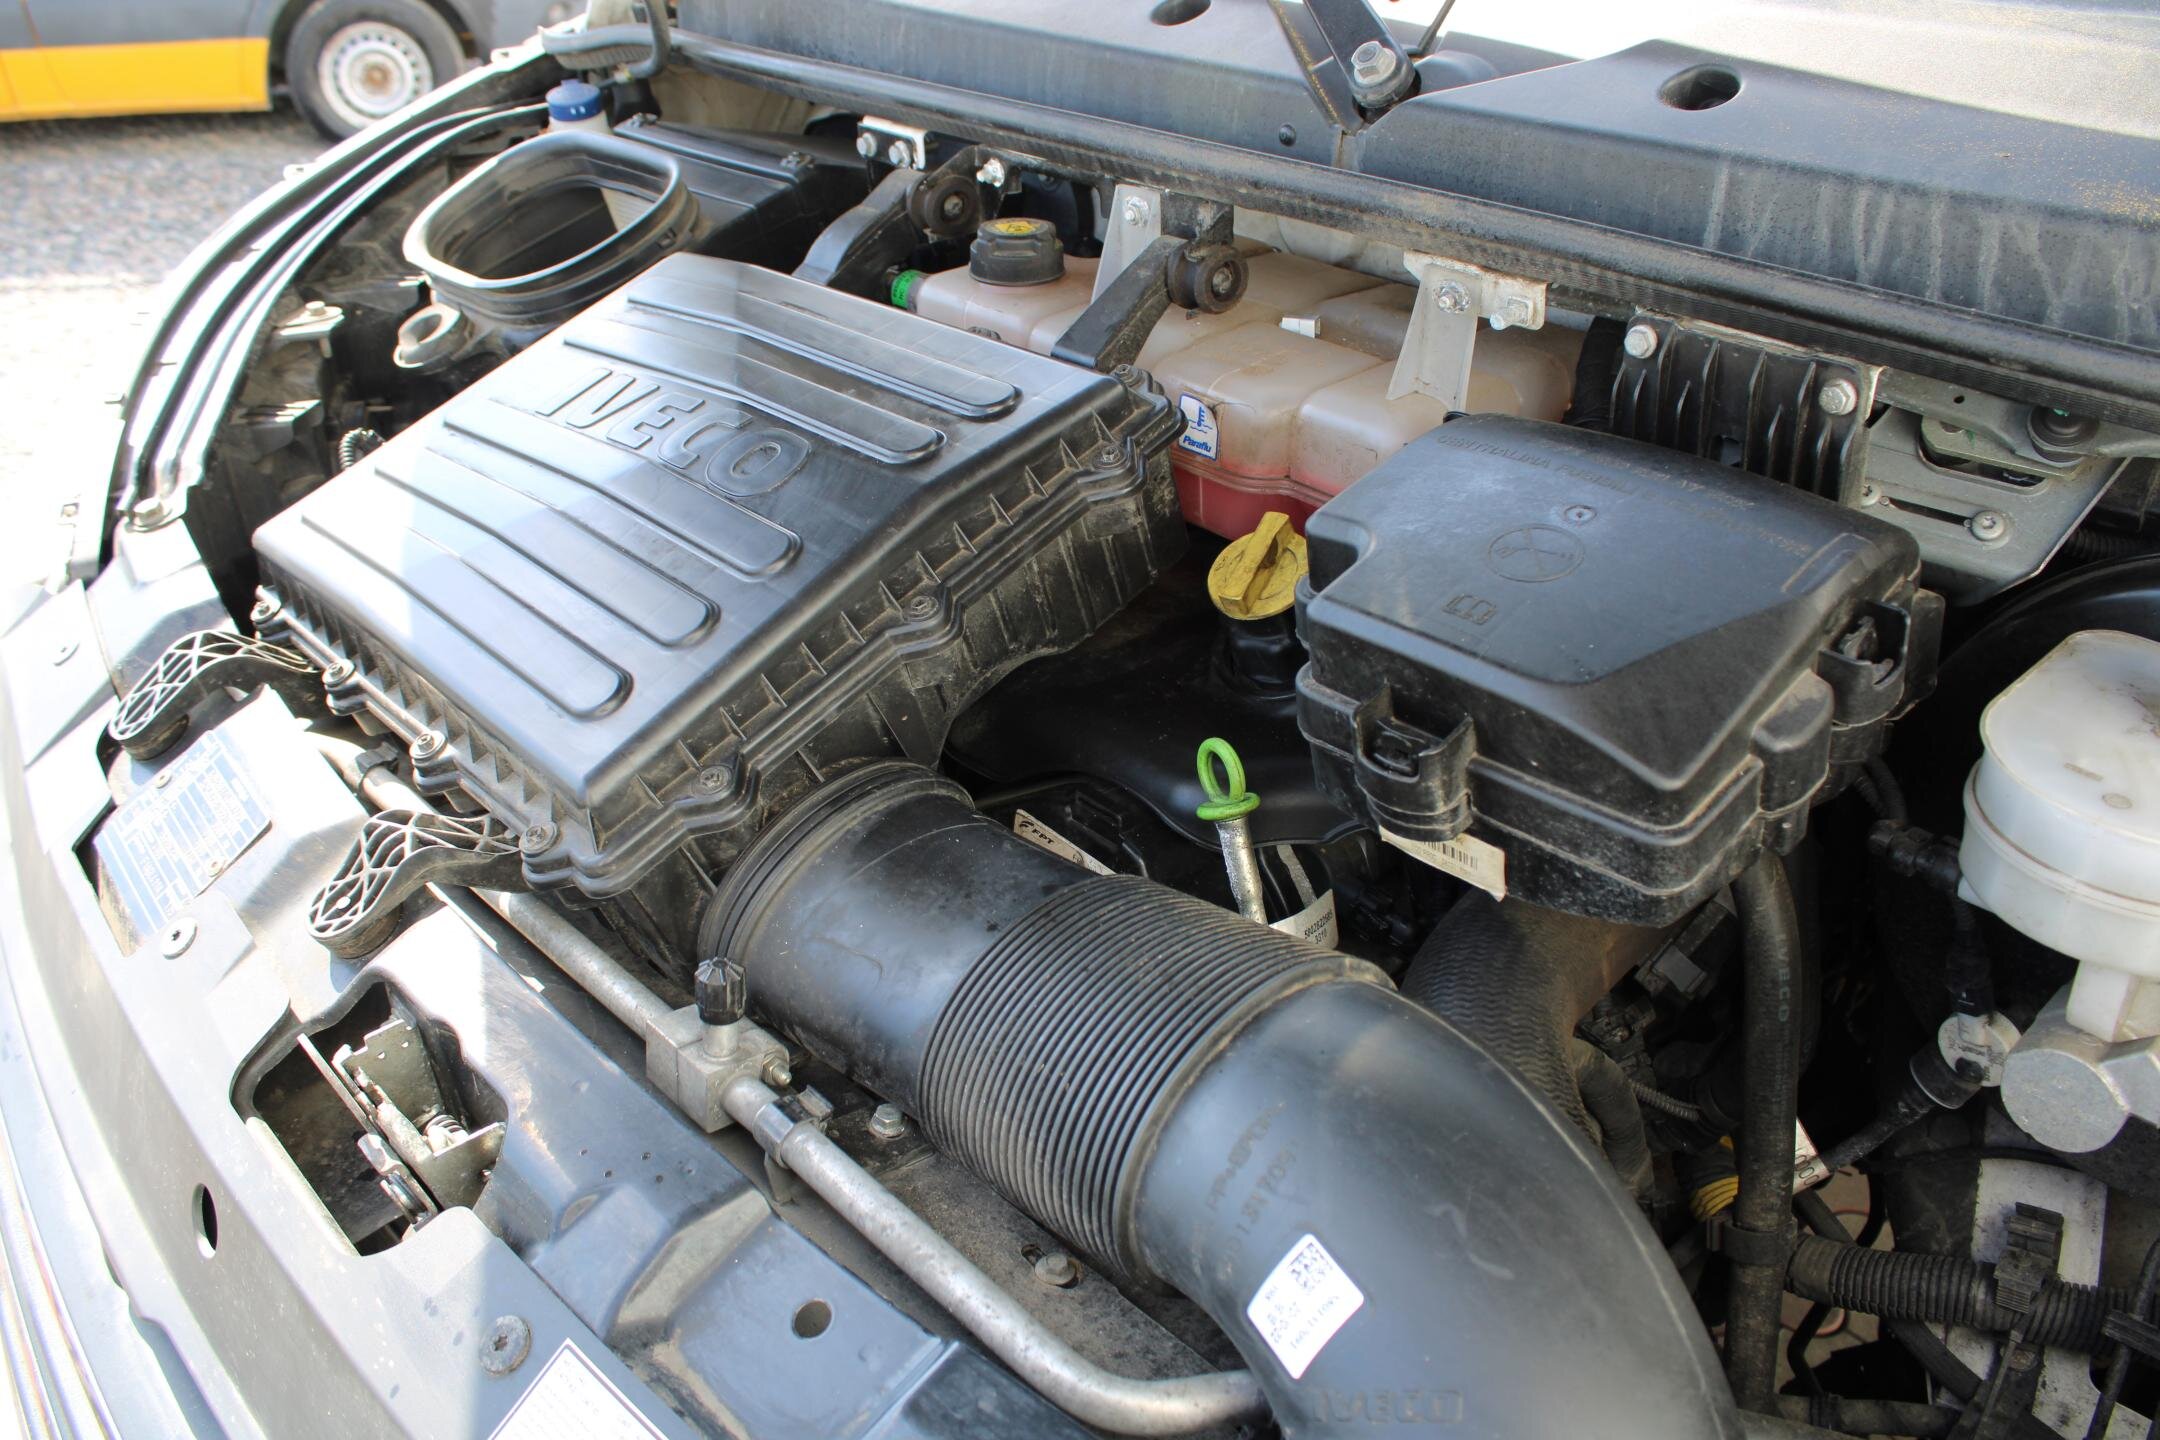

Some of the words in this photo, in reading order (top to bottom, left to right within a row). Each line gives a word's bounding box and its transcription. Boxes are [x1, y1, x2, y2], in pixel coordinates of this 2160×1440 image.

[535, 367, 813, 498] IVECO
[1182, 435, 1213, 454] Paraflu
[1032, 828, 1055, 845] FPT
[1775, 932, 1791, 1023] IVECO
